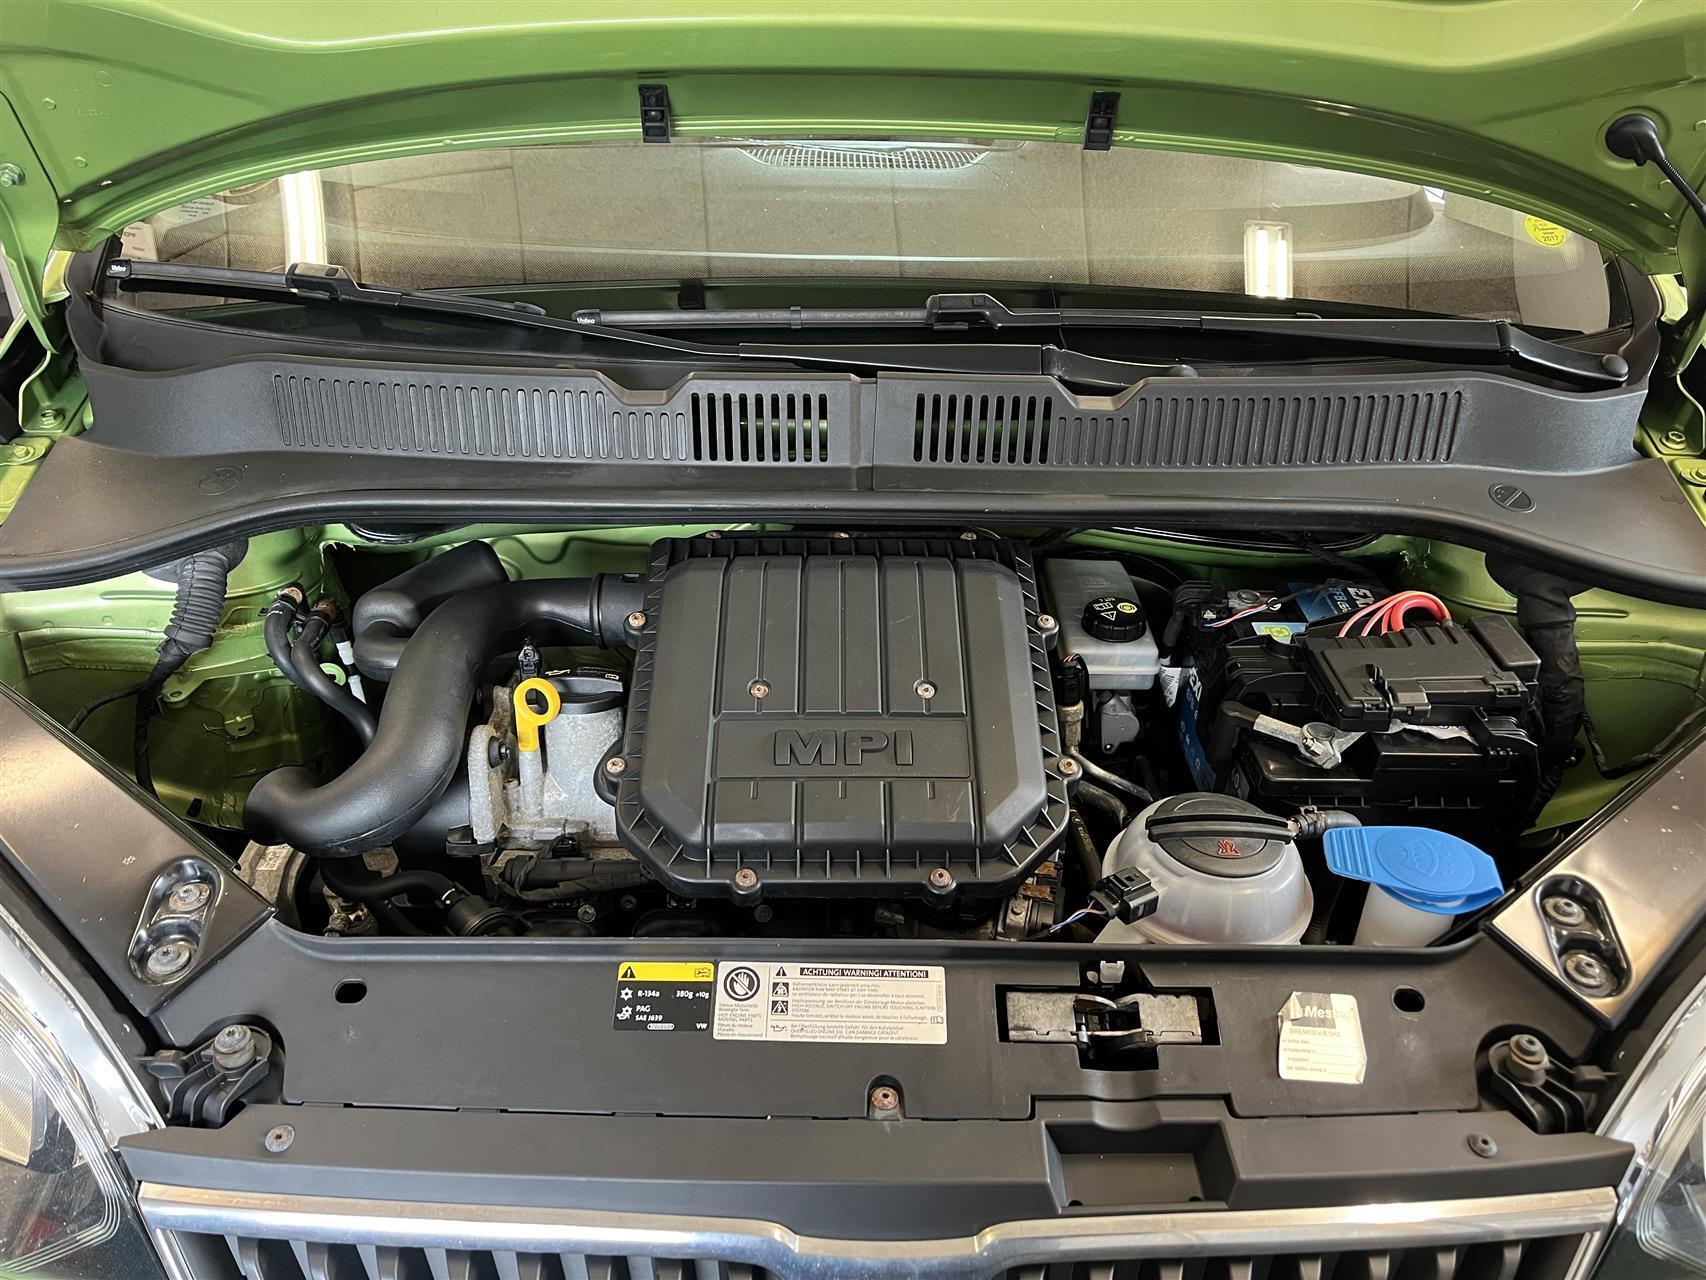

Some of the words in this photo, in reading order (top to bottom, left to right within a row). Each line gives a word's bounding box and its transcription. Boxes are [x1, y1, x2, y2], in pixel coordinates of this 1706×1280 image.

[773, 729, 914, 766] MPI
[802, 968, 842, 976] ACHTUNG!
[843, 968, 882, 977] WARNING!
[883, 970, 926, 978] ATTENTION!
[637, 989, 660, 998] R-134a
[676, 990, 694, 999] 380g
[635, 1004, 651, 1012] PAG
[635, 1014, 647, 1022] SAE
[696, 1022, 708, 1030] VW
